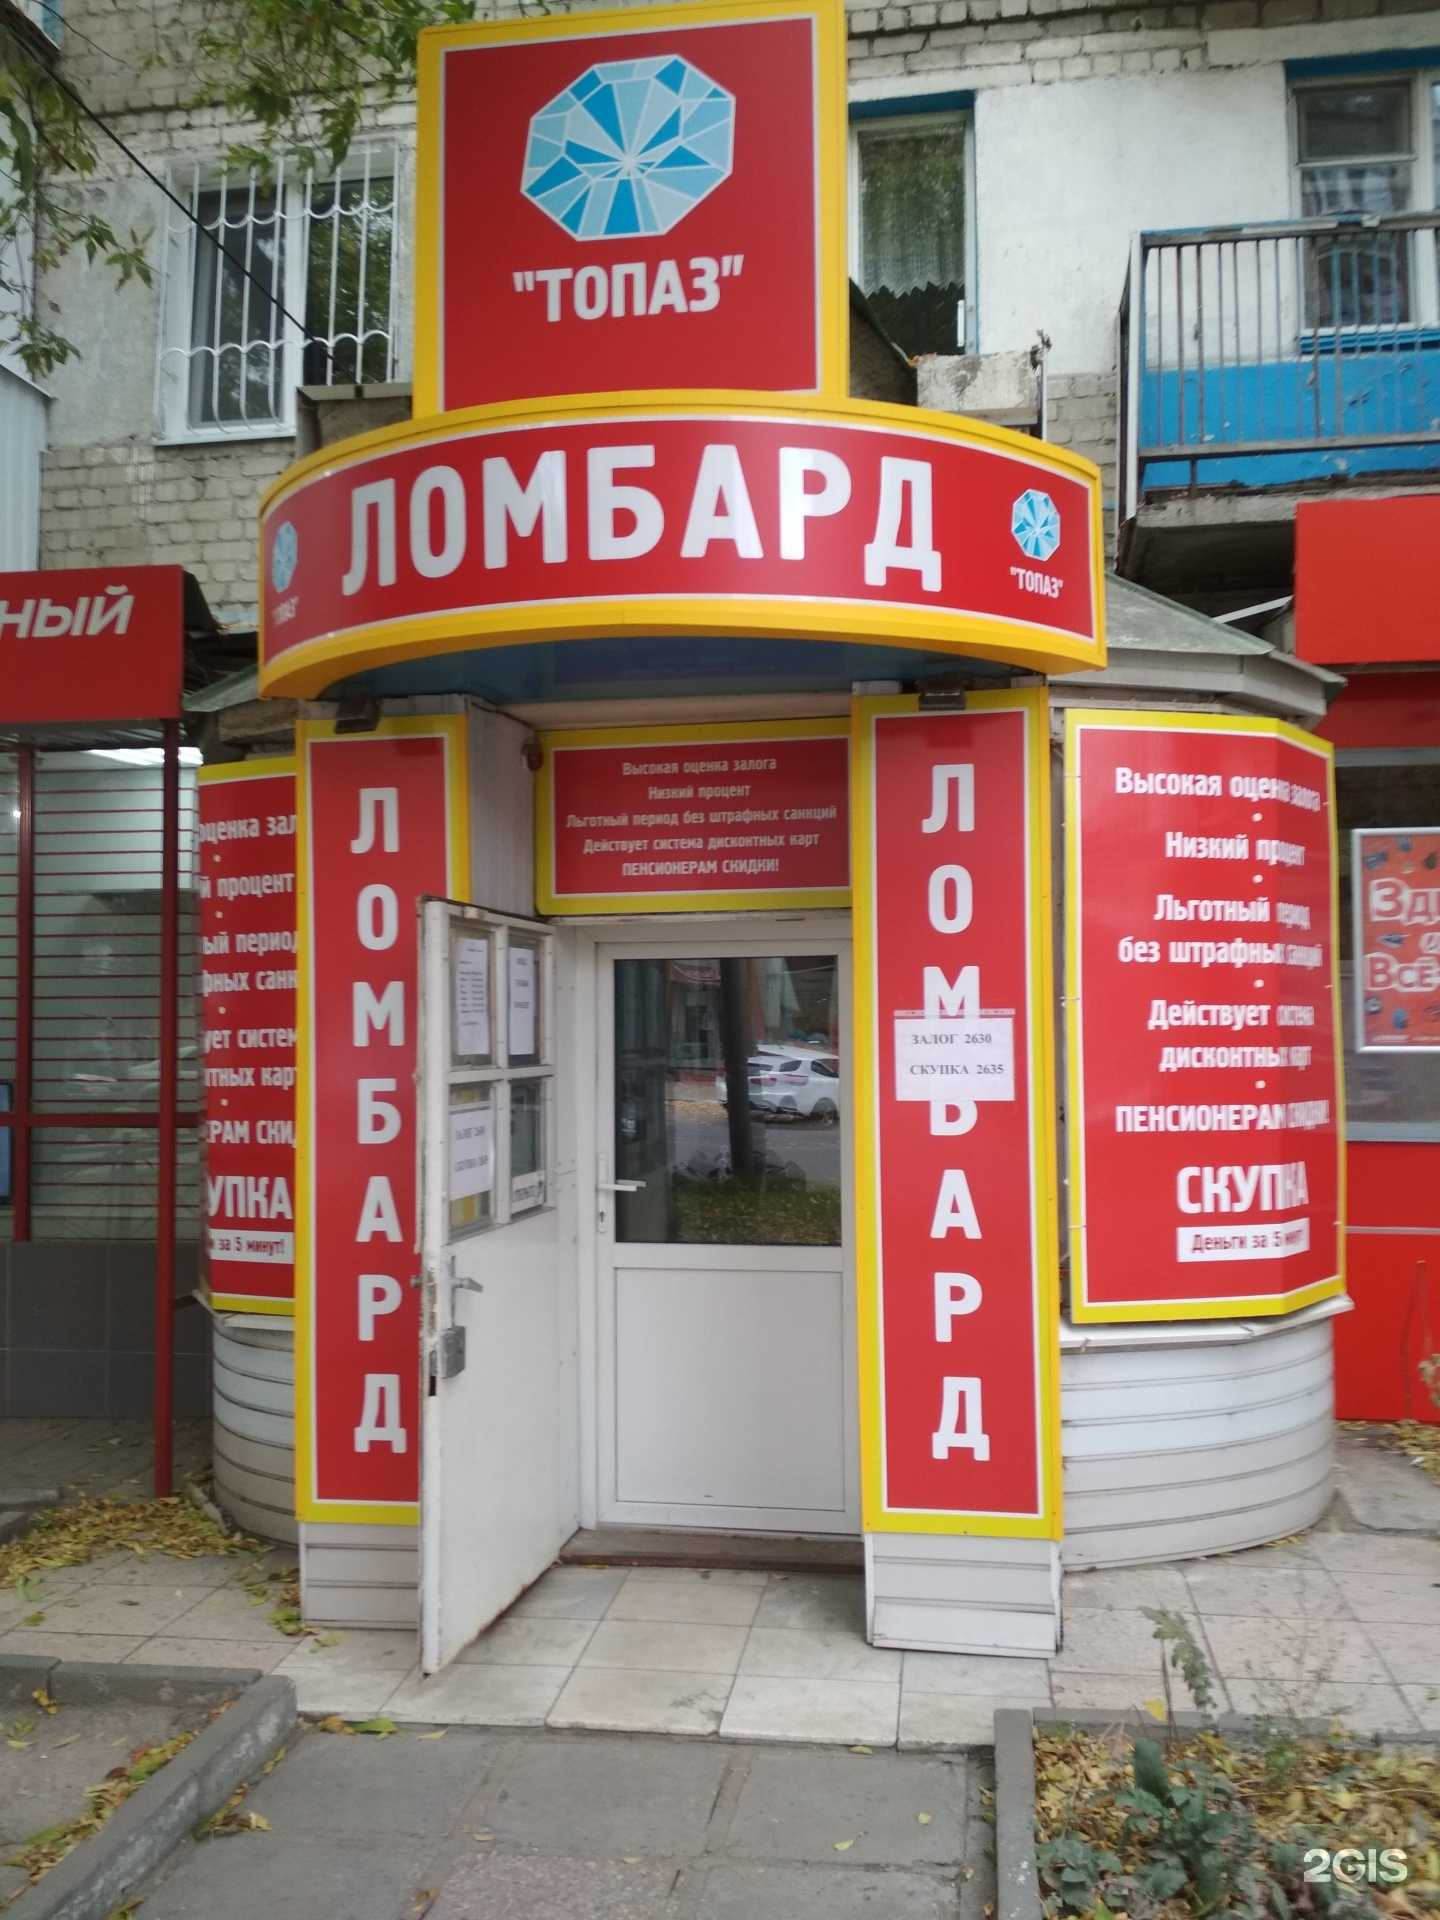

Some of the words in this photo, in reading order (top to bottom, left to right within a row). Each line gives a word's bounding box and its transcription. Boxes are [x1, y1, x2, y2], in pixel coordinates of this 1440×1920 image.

[512, 254, 744, 323] "ТОПАЗ"
[341, 443, 943, 597] ЛОМБАРД
[1009, 566, 1064, 599] "ТОПАЗ"
[622, 762, 679, 776] Высокая
[683, 760, 729, 775] оценка
[734, 758, 777, 772] залога
[648, 785, 694, 800] Низкий
[698, 785, 751, 800] процент
[1115, 767, 1222, 796] Высокая
[583, 838, 649, 855] Действует
[1165, 832, 1249, 859] Низкий
[622, 861, 718, 876] ПЕНСИОНЕРАМ
[722, 858, 780, 875] СКИДКИ!
[217, 872, 295, 902] процент
[1154, 895, 1270, 921] Льготный
[1118, 936, 1161, 962] без
[1147, 1000, 1271, 1031] Действует
[911, 1033, 959, 1046] ЗАЛОГ
[964, 1032, 992, 1044] 2630
[909, 1064, 969, 1076] СКУПКА
[976, 1064, 1004, 1075] 2635
[350, 787, 408, 1453] ЛОМБАРД
[1191, 1233, 1248, 1255] Деньги
[1252, 1234, 1269, 1249] за
